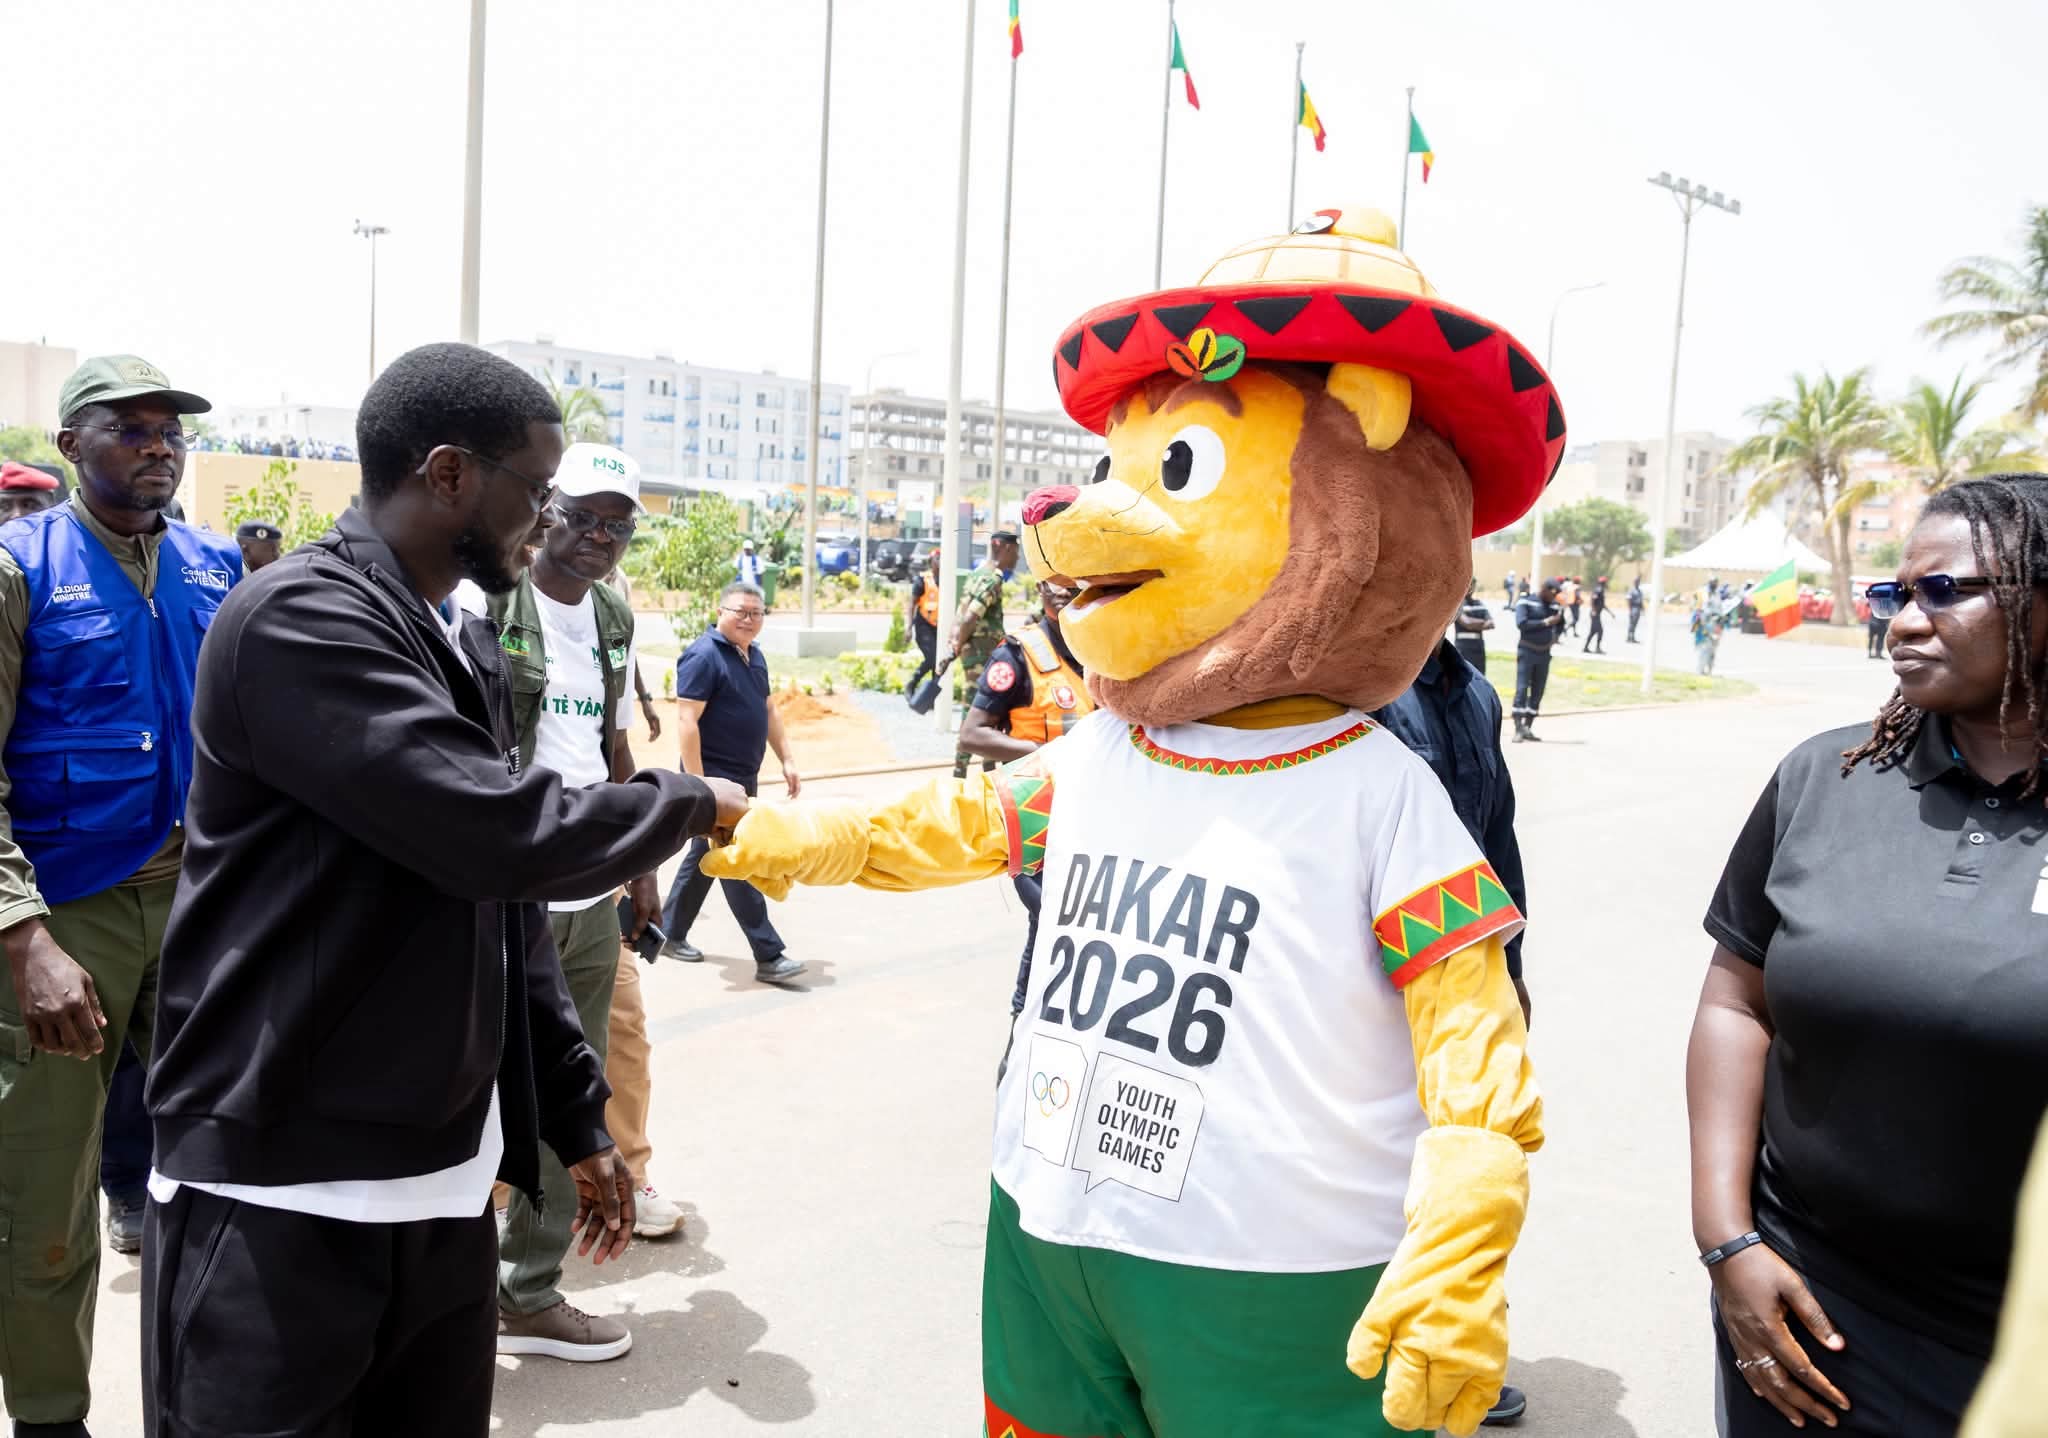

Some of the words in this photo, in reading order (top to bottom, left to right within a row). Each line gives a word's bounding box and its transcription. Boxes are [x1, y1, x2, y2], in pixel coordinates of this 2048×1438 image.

[593, 457, 624, 475] MJS
[52, 591, 91, 604] MINISTRE
[1057, 853, 1260, 974] DAKAR
[1039, 935, 1233, 1067] 2026
[1116, 1080, 1177, 1121] YOUTH
[1097, 1103, 1180, 1150] OLYMPIC
[1098, 1131, 1165, 1174] GAMES
